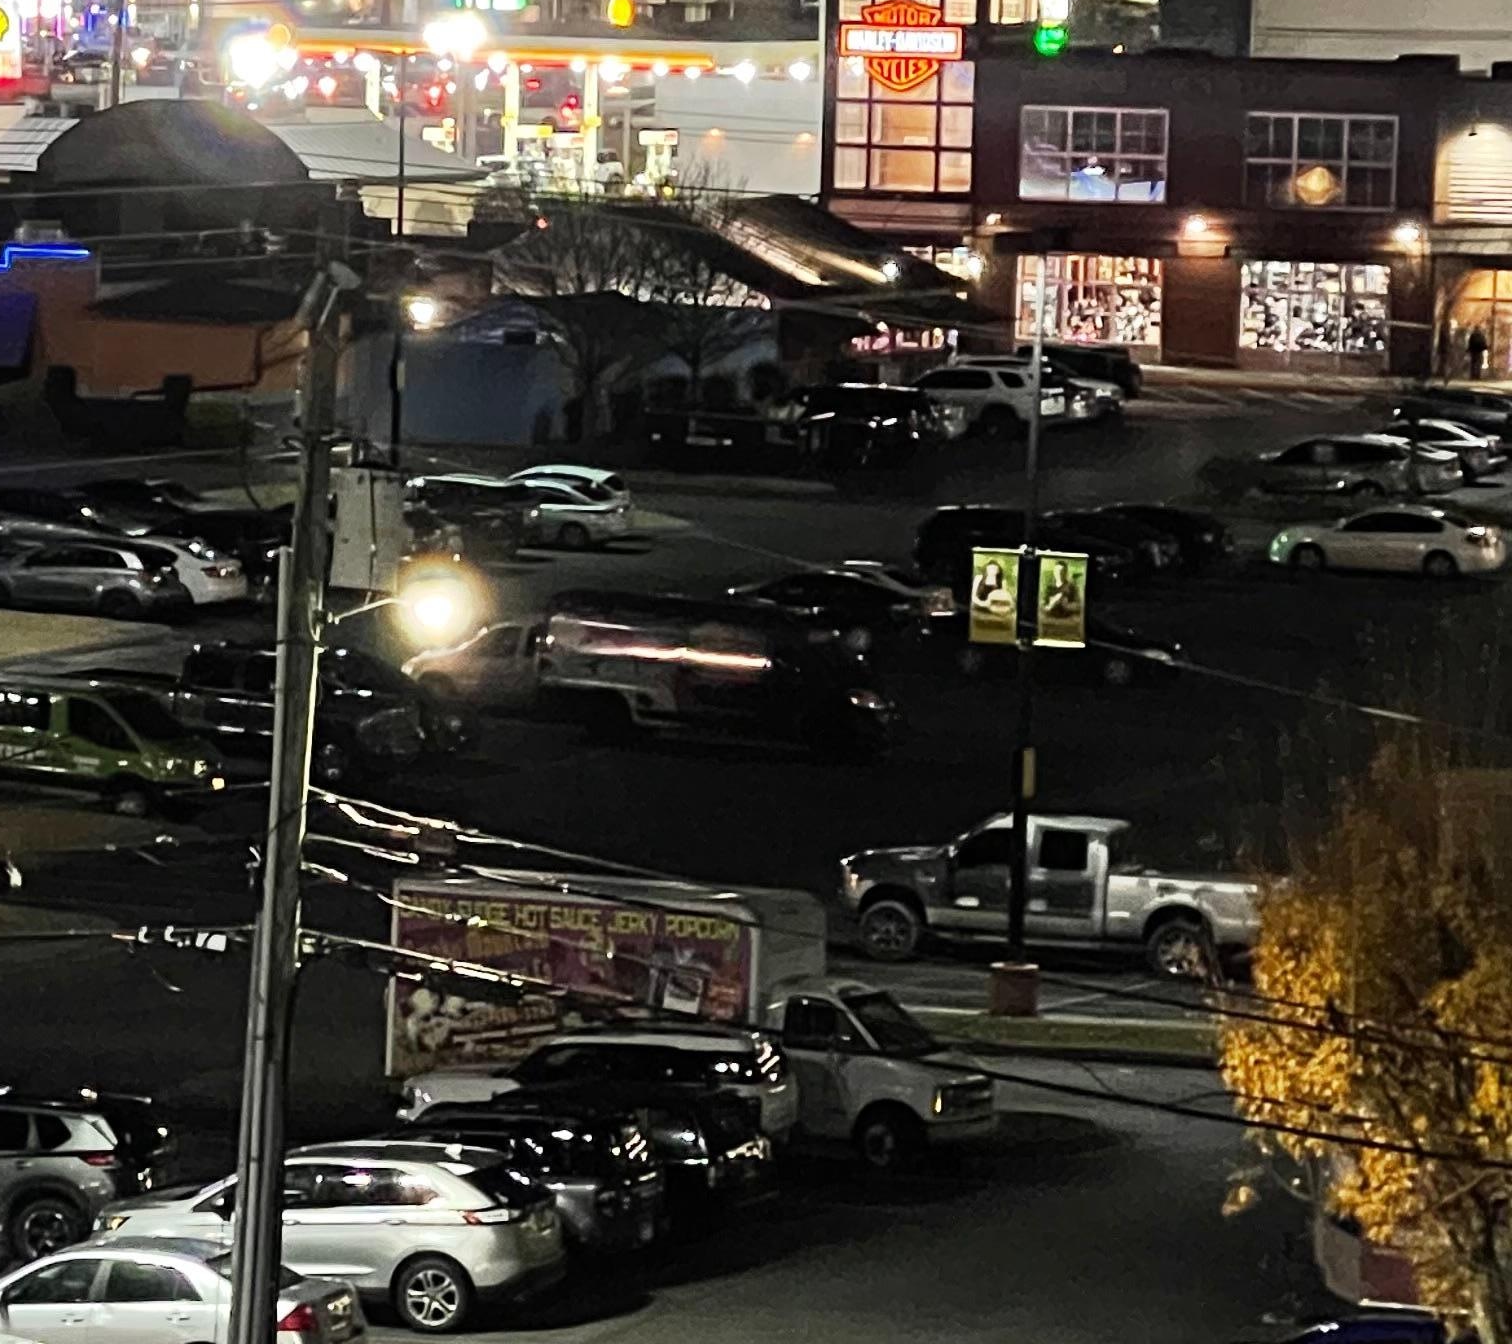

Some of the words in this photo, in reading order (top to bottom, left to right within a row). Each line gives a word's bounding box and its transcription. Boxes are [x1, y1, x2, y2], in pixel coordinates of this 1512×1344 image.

[873, 5, 931, 25] MOTOR
[871, 58, 929, 83] CYCLES
[514, 903, 548, 928] HOT
[550, 906, 603, 930] SAUCE
[606, 910, 659, 935] JERKY
[664, 914, 740, 941] POPCORN
